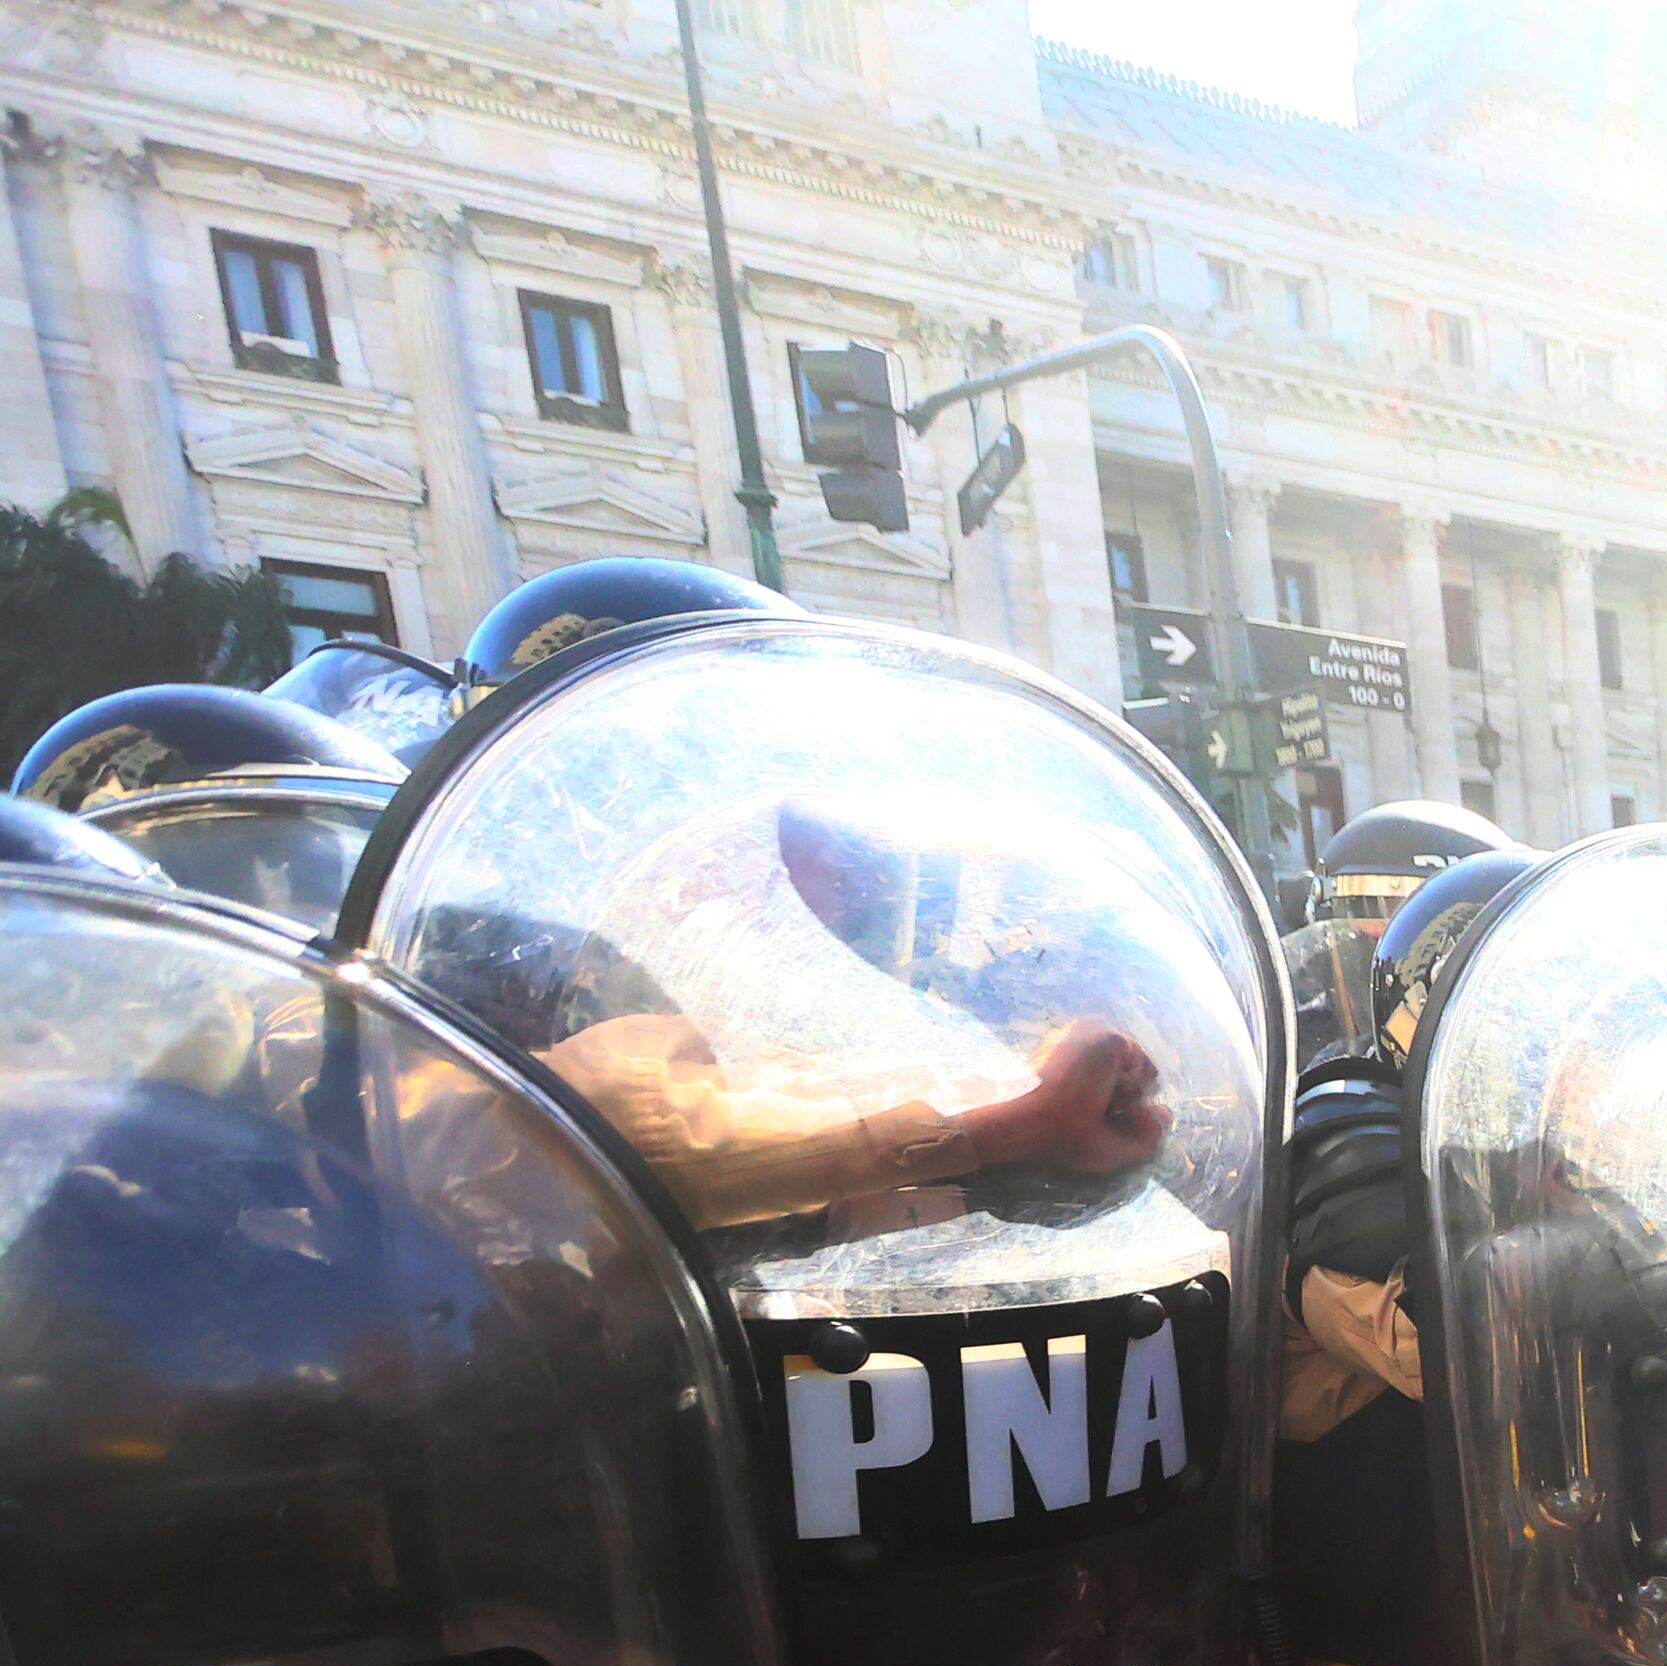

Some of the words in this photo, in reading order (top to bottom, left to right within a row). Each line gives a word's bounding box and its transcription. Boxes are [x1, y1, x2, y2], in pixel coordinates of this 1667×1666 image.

[1328, 638, 1400, 666] Avenida
[1309, 655, 1360, 681] Entre
[1348, 686, 1379, 707] 100
[1393, 691, 1405, 711] 0
[783, 1317, 1188, 1540] PNA
